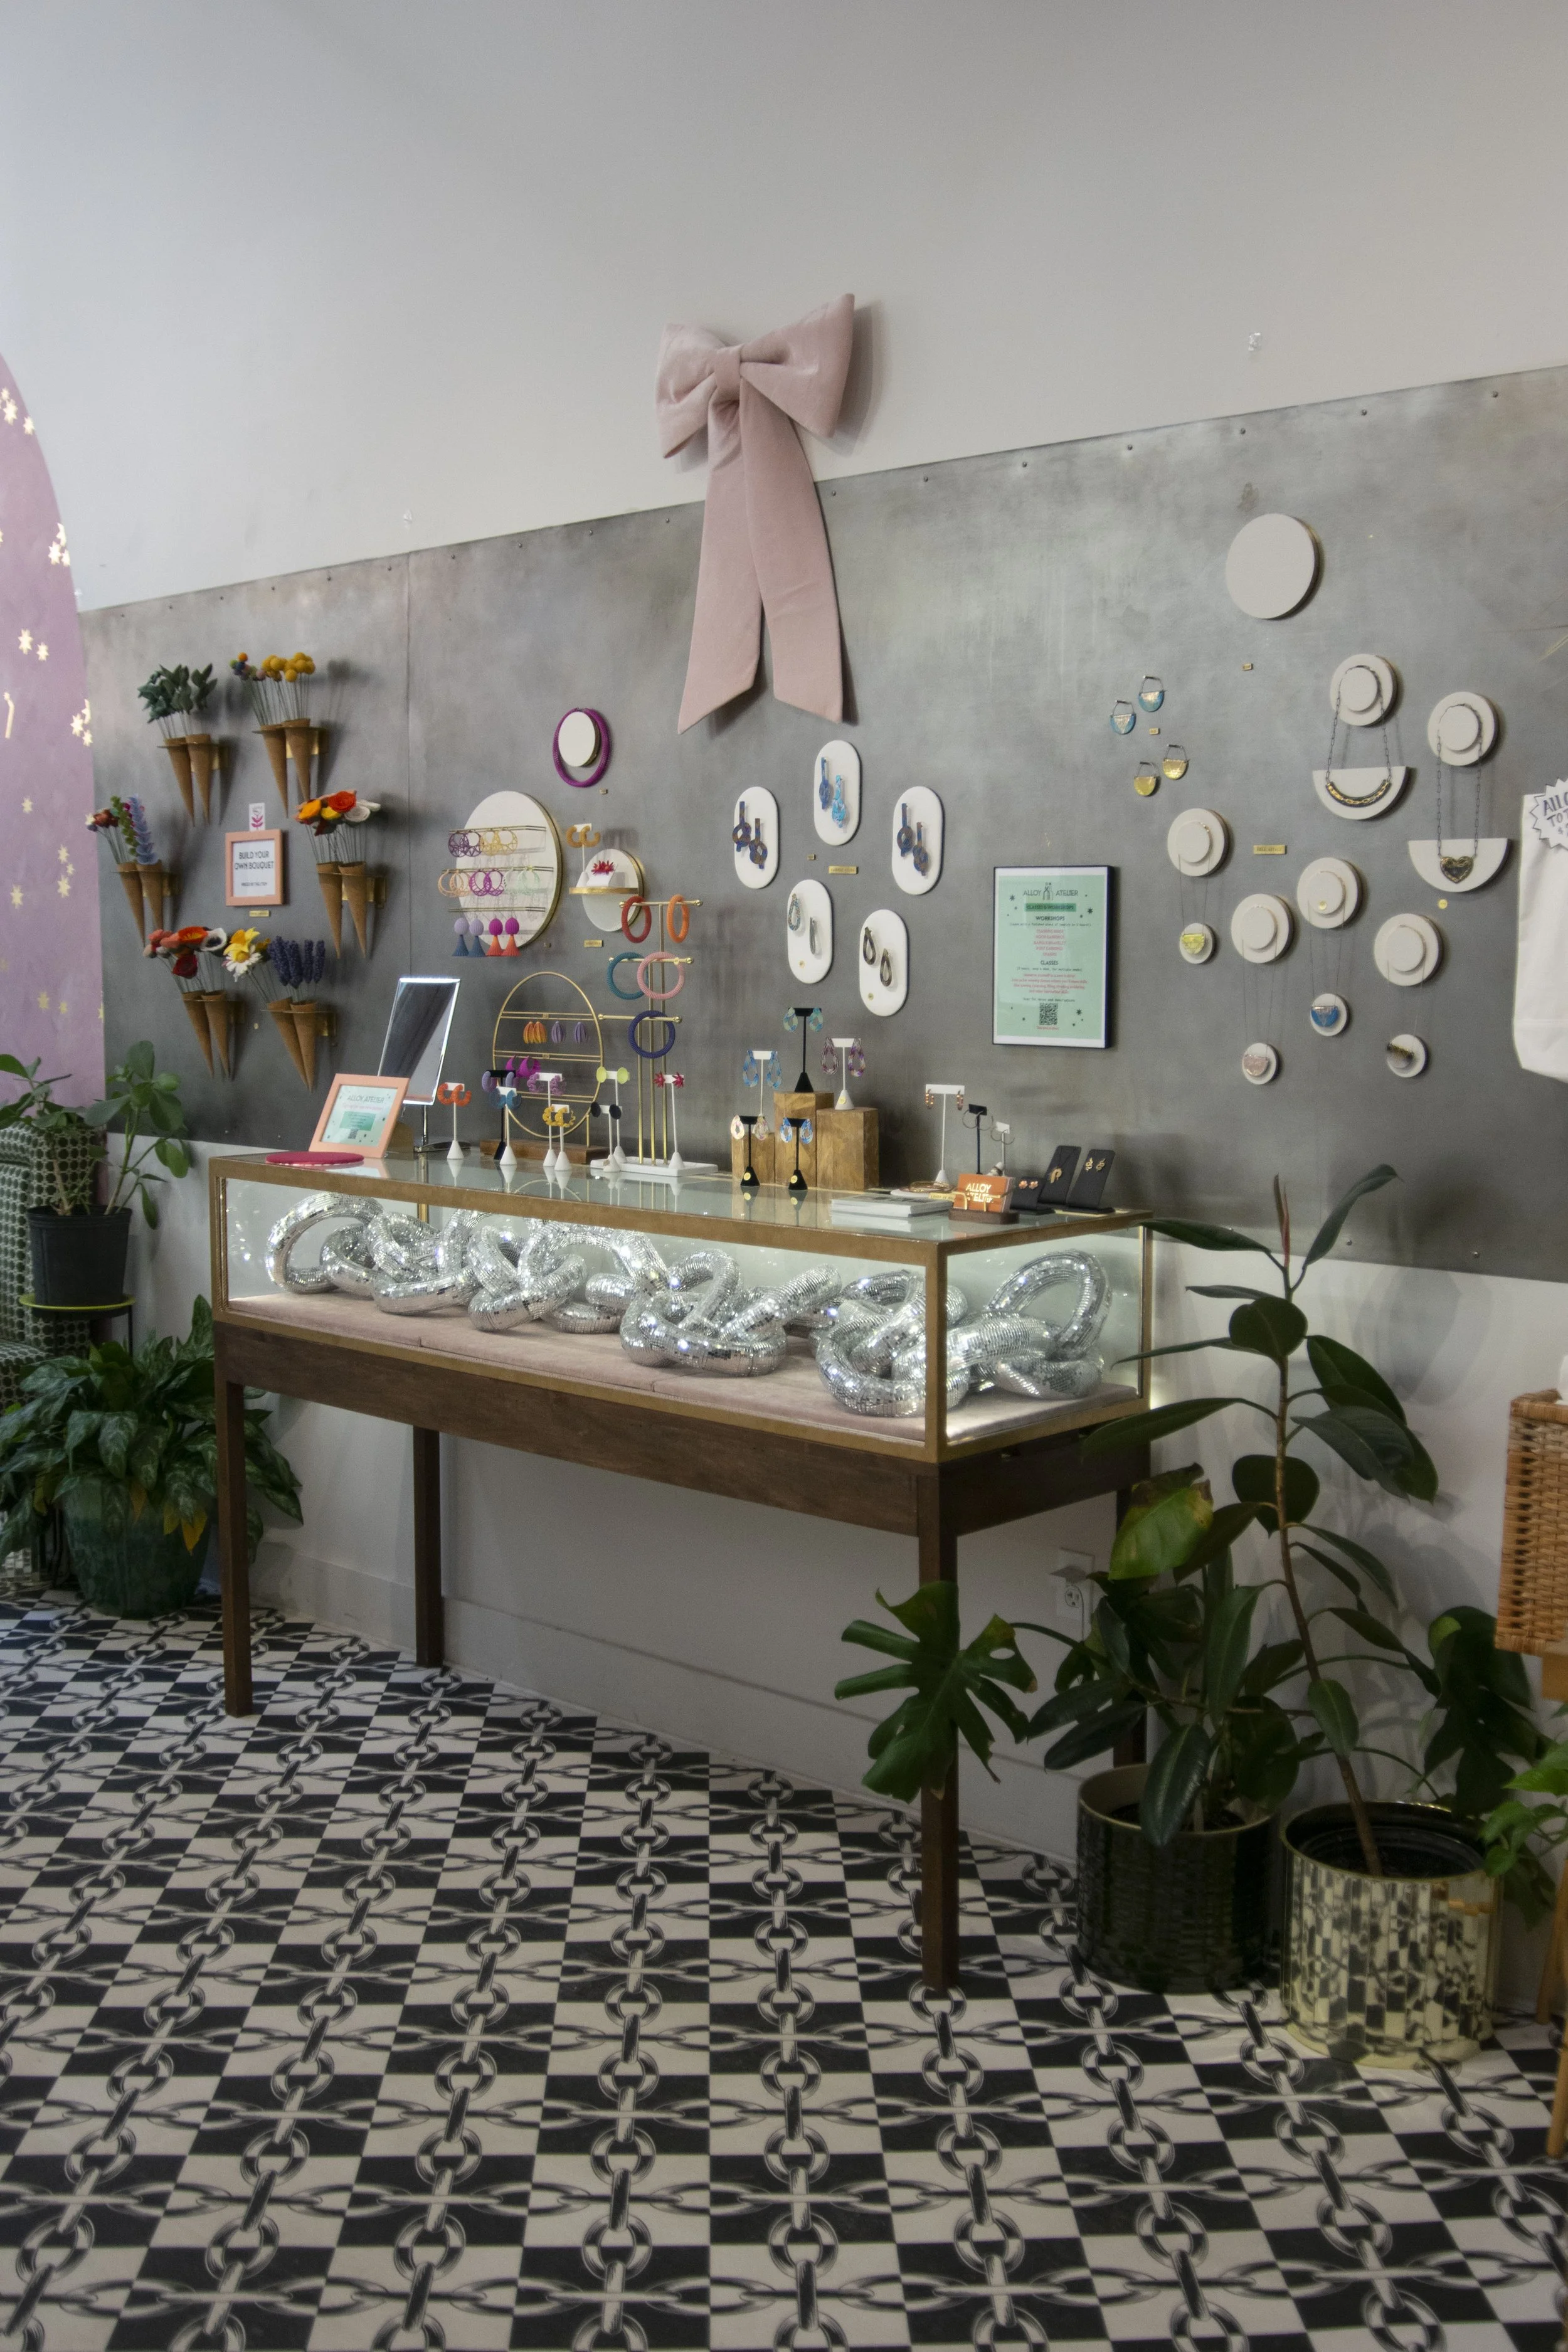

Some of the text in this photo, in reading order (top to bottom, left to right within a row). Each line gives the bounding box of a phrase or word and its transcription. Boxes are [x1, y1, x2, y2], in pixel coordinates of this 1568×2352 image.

[255, 850, 269, 859] YOUR
[249, 861, 274, 869] BOUQUET
[966, 1183, 992, 1193] ALLOY
